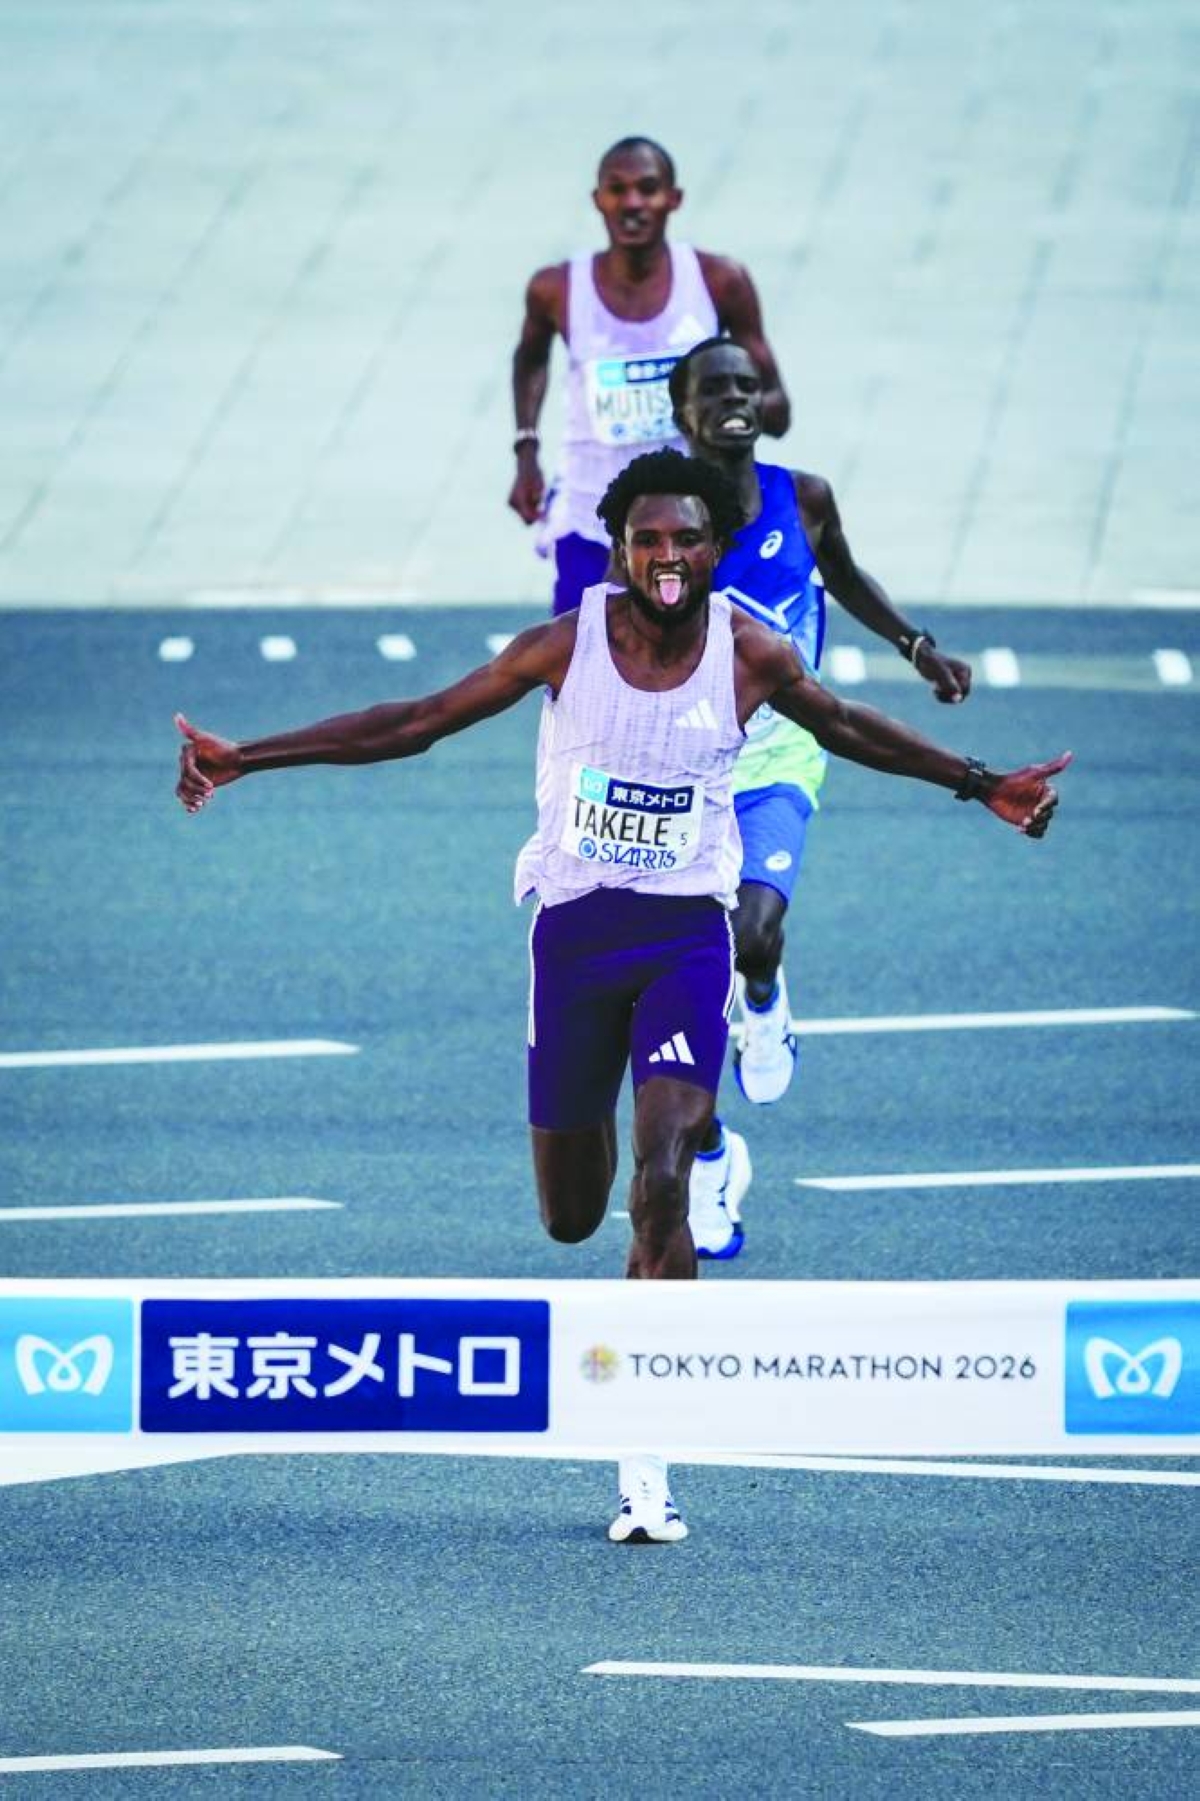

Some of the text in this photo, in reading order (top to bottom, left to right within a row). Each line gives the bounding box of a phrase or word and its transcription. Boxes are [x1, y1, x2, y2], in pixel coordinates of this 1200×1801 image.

[611, 788, 690, 808] 東京メトロ
[574, 797, 672, 847] TAKELE
[680, 832, 688, 846] 5
[168, 1332, 521, 1400] 東京メトロ
[629, 1354, 1037, 1380] TOKYO MARATHON 2026
